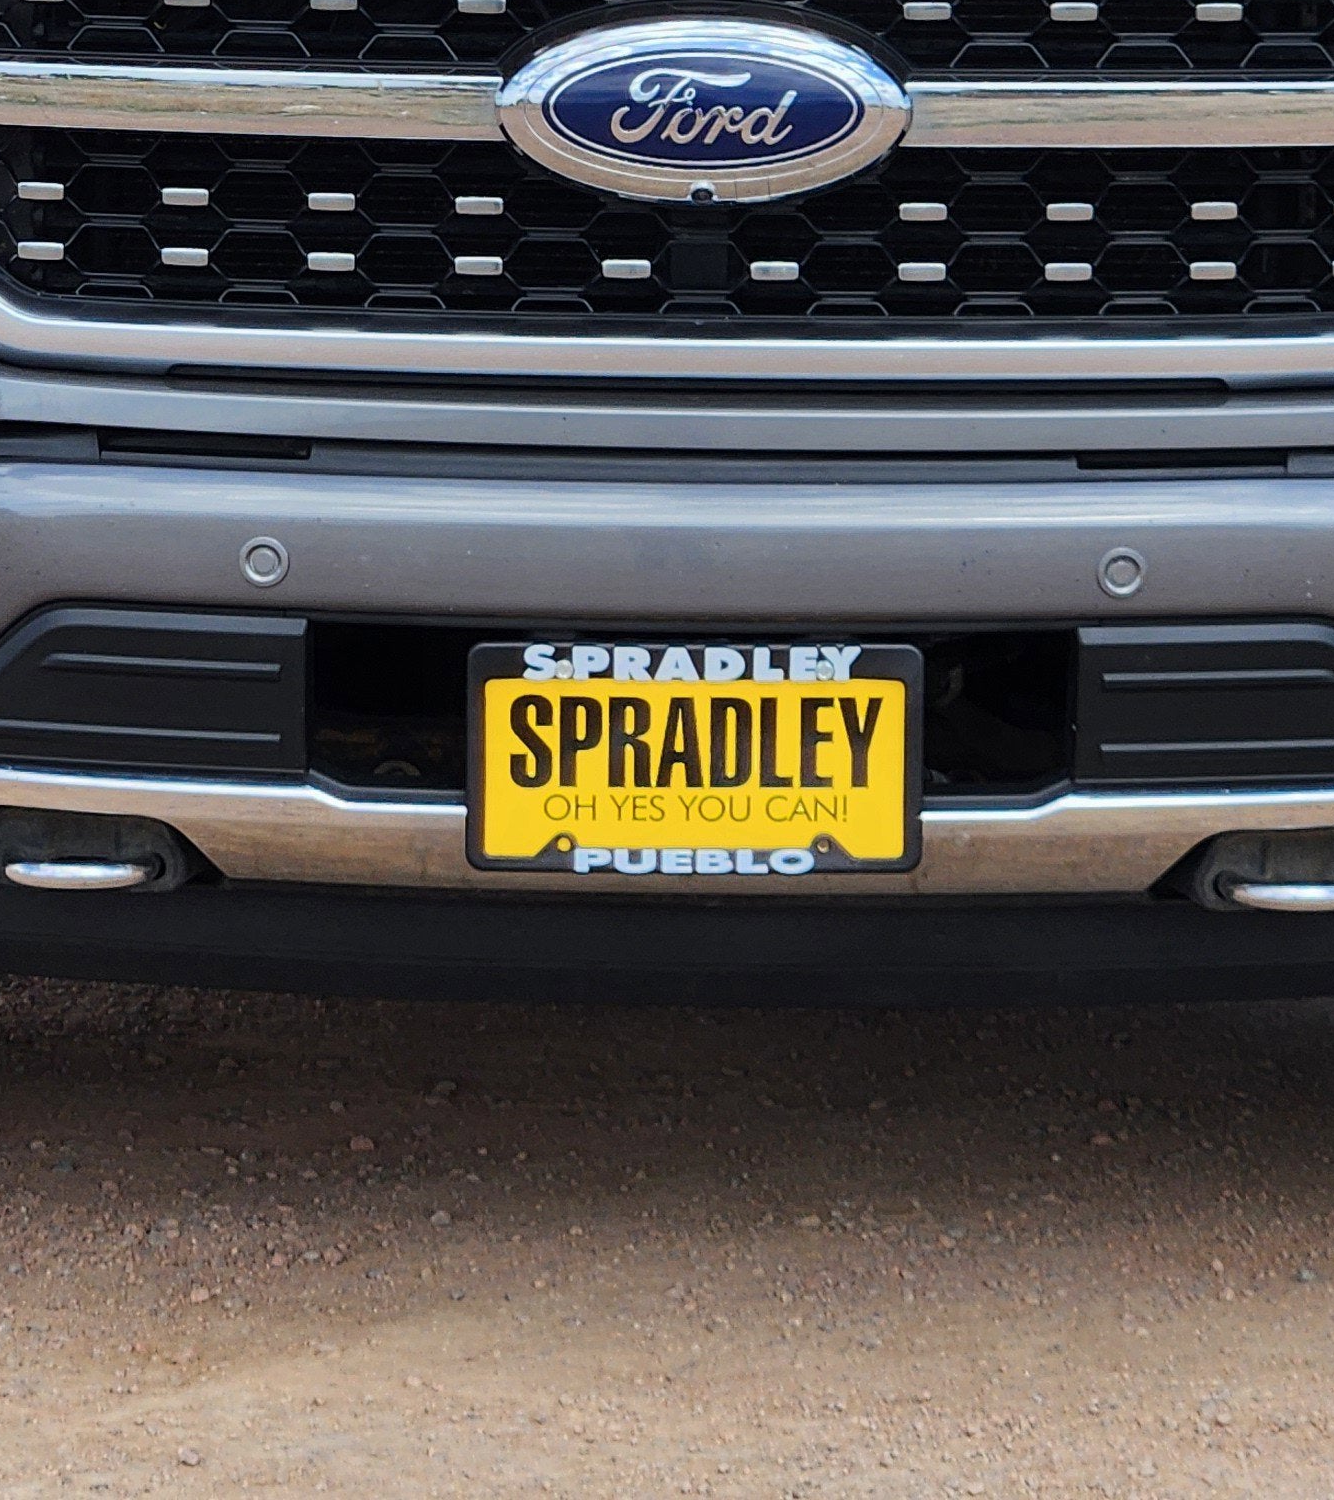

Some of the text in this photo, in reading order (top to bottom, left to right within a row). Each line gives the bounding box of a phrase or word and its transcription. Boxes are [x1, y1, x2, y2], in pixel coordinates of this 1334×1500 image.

[610, 67, 797, 145] Ford
[509, 694, 884, 789] SPRADLEY
[543, 793, 848, 823] OH YES YOU CAN!
[573, 848, 815, 875] PUEBLO
